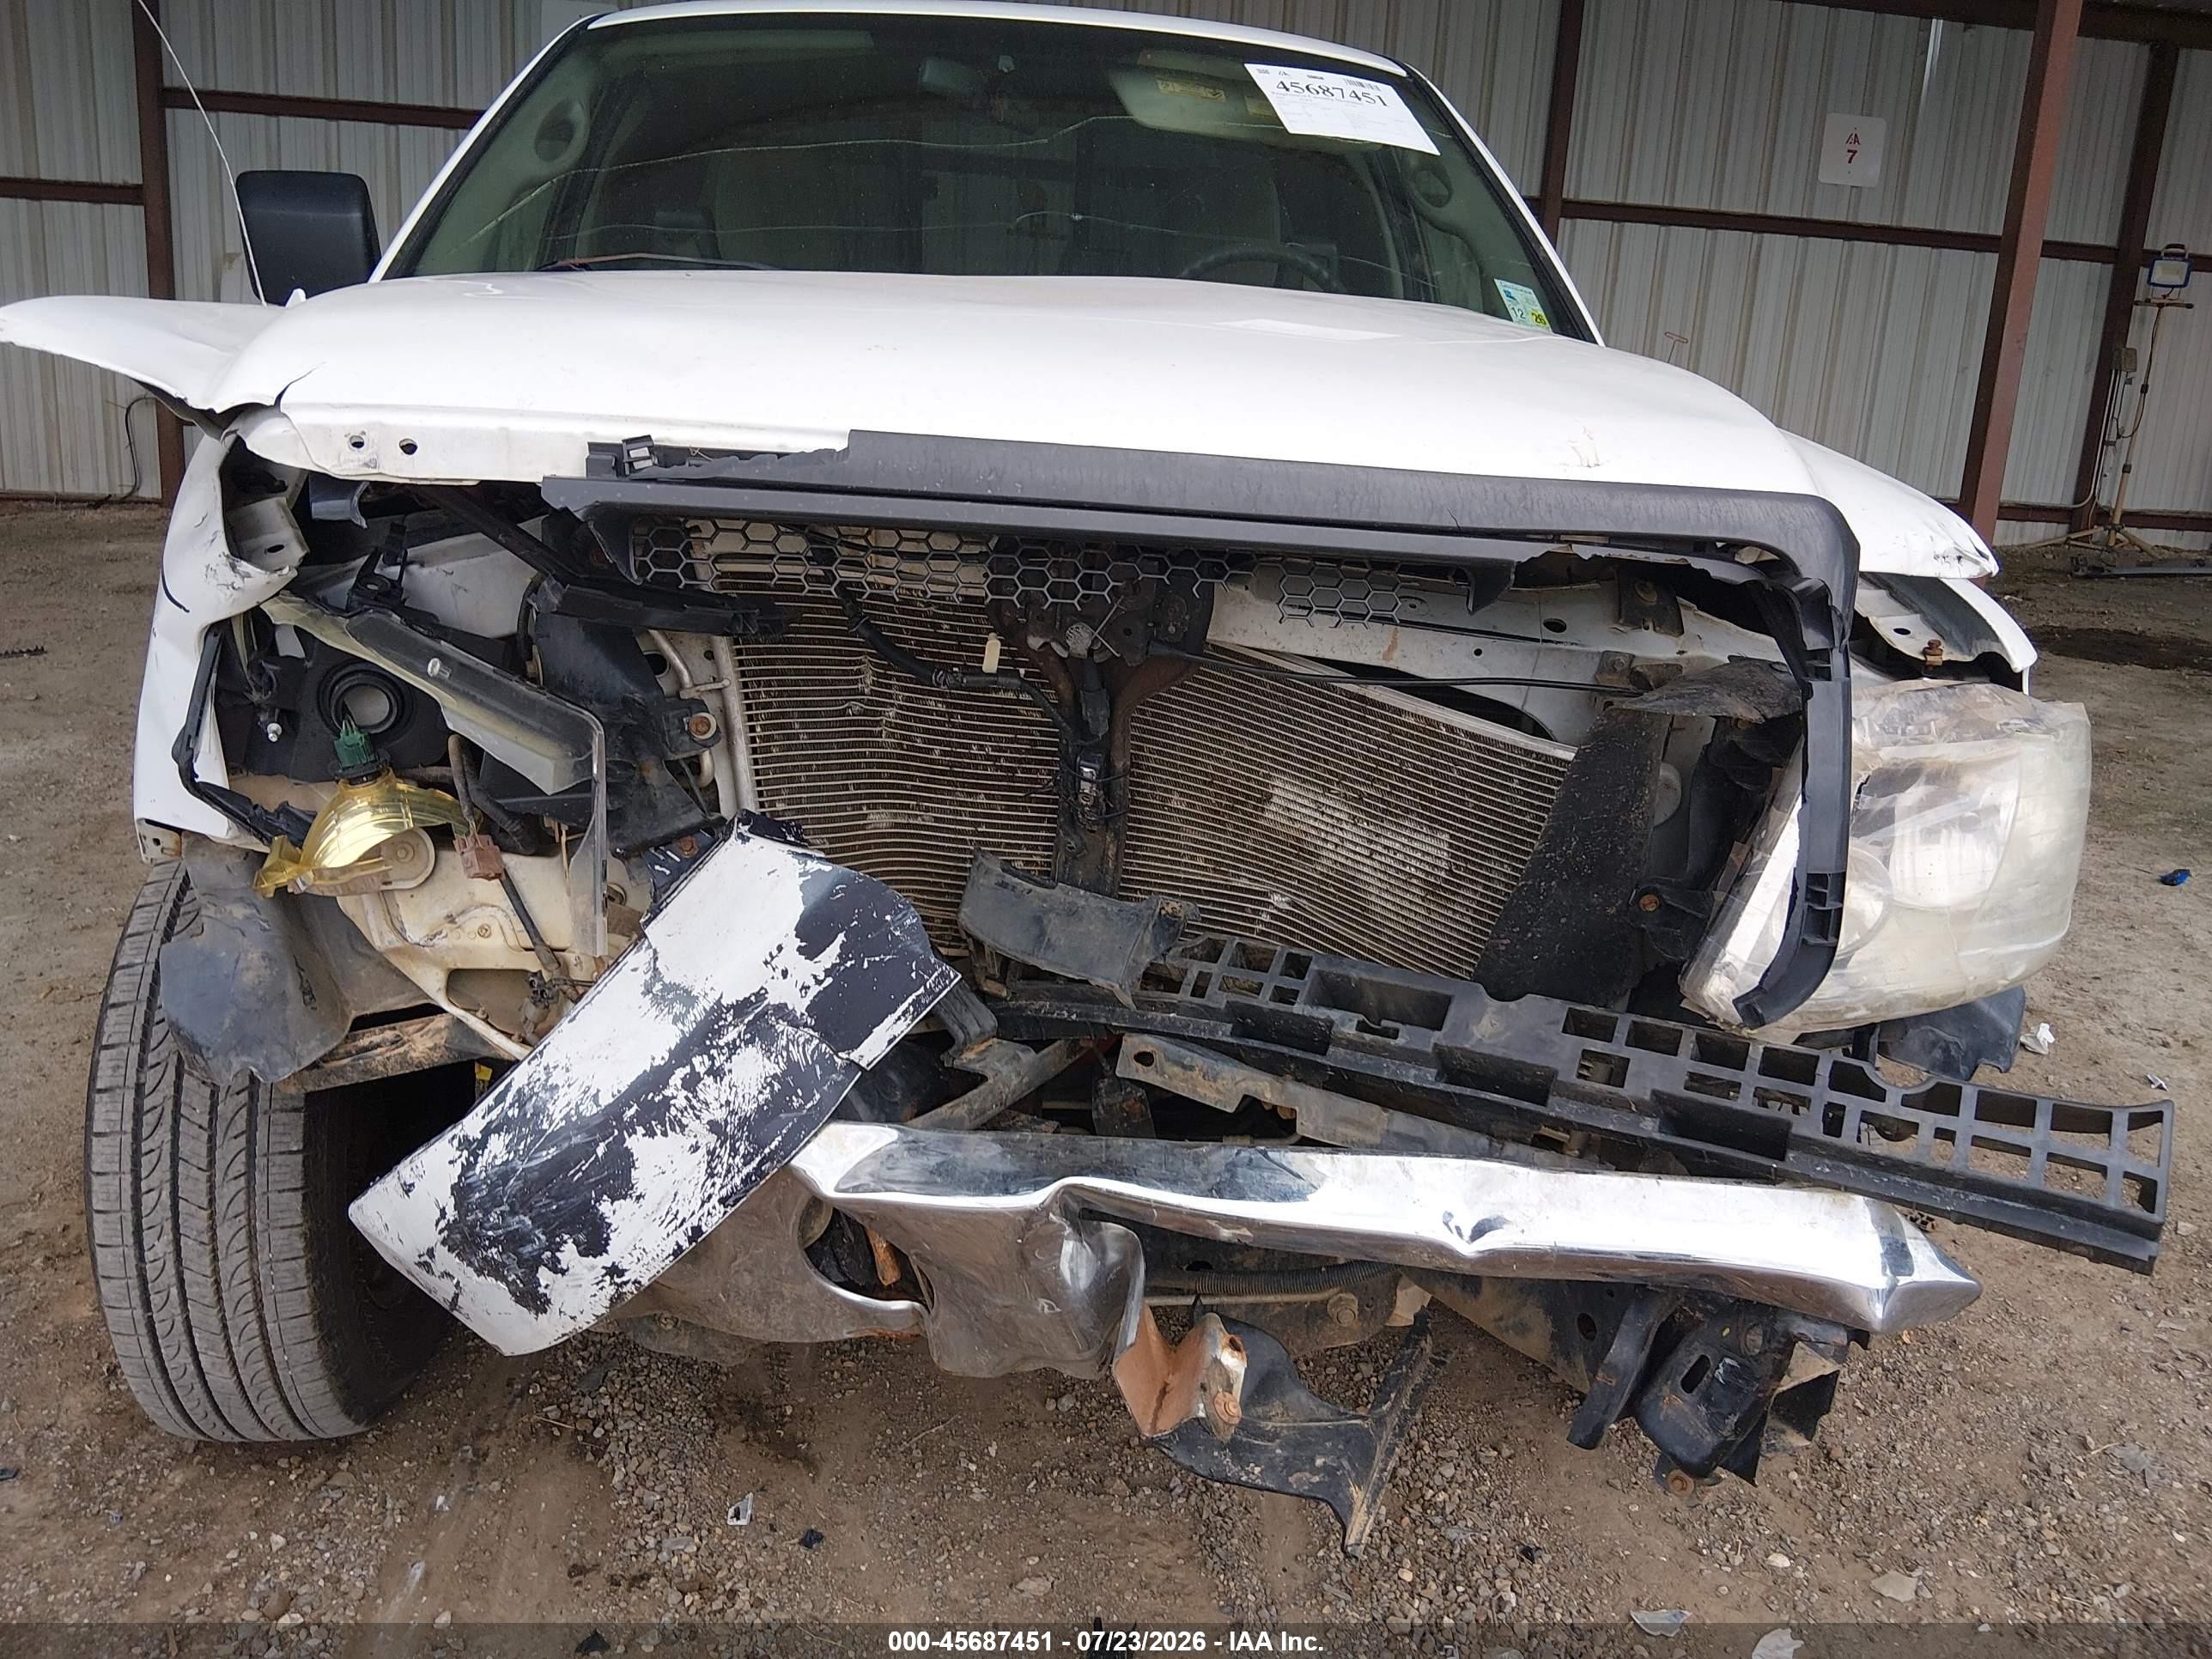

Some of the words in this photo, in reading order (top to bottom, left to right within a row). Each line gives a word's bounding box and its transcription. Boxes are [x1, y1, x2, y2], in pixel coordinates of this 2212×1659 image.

[1276, 80, 1389, 107] 45687451
[1847, 149, 1858, 164] 7
[1511, 307, 1526, 319] 12
[1531, 313, 1547, 325] 26
